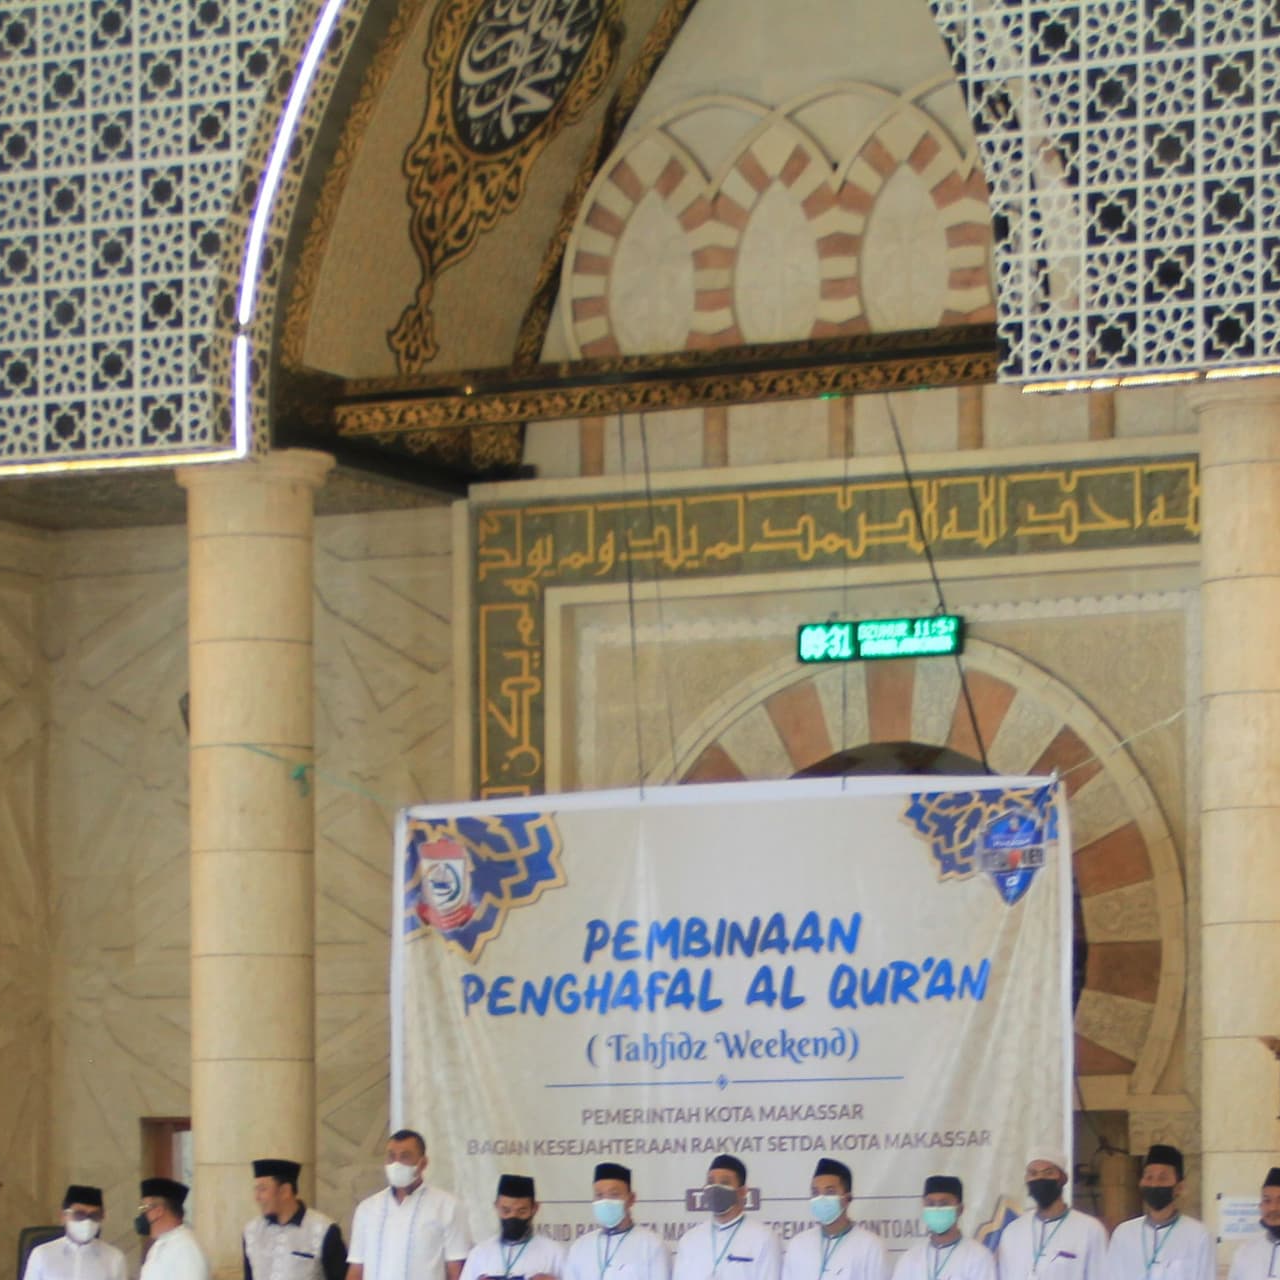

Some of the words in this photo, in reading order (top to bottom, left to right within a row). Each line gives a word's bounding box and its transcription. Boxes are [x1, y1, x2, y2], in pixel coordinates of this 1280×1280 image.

[583, 910, 862, 964] PEMBINAAN
[460, 968, 724, 1017] PENGHAFAL
[745, 965, 806, 1010] AL
[828, 956, 991, 1010] QUR'AN
[582, 1107, 701, 1125] PEMERINTAH
[705, 1106, 755, 1123] KOTA
[759, 1104, 864, 1121] MAKASSAR
[467, 1139, 529, 1156] BAGIAN
[533, 1137, 687, 1156] KESEJAHTERAAN
[693, 1136, 763, 1153] RAKYAT
[768, 1134, 827, 1152] SETDA
[831, 1133, 880, 1150] KOTA
[884, 1130, 992, 1149] MAKASSAR
